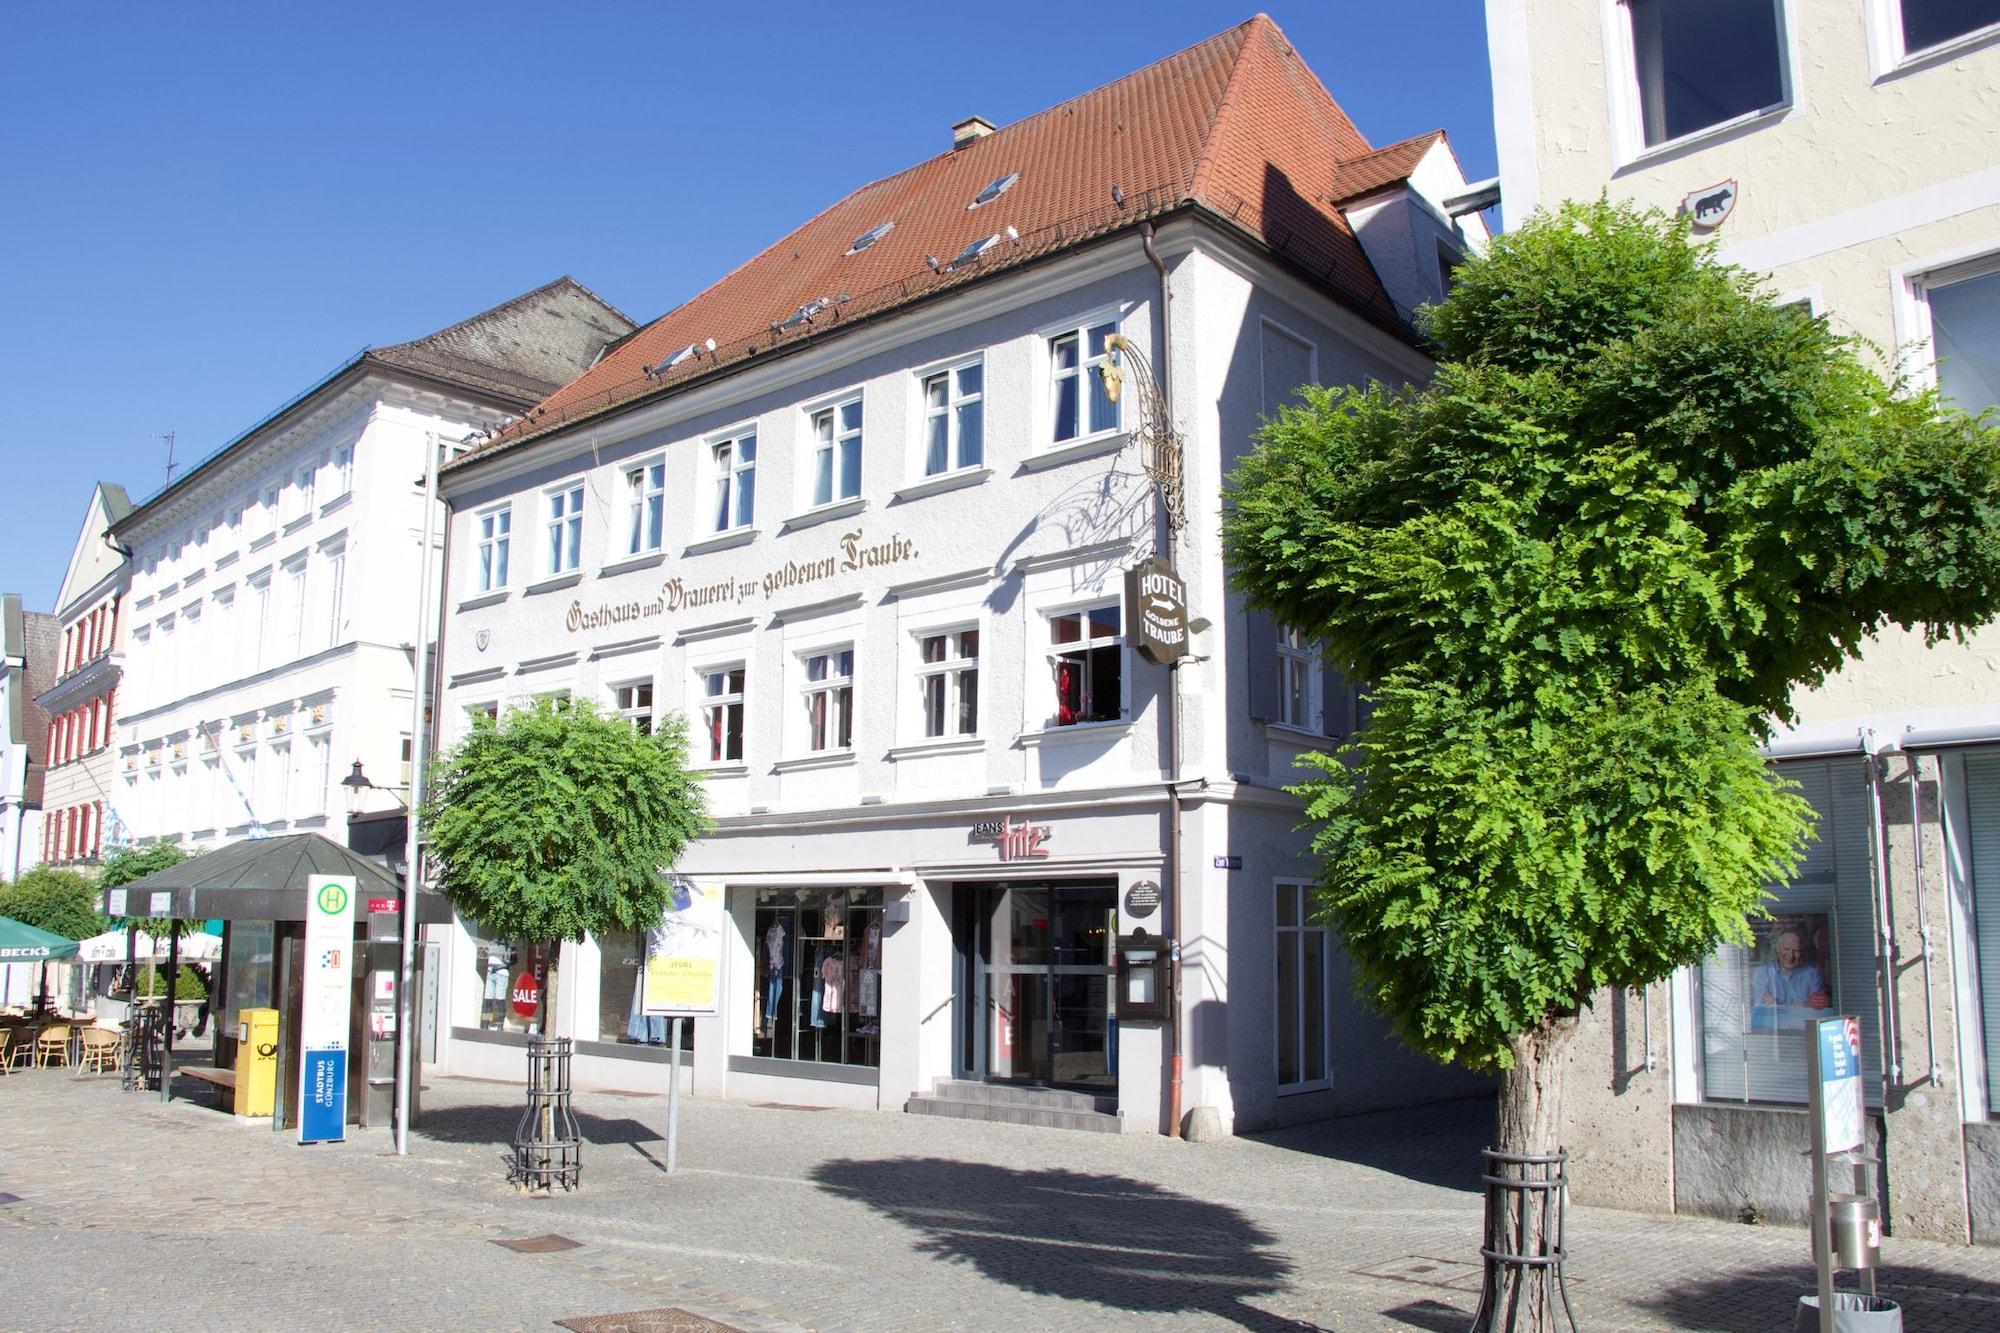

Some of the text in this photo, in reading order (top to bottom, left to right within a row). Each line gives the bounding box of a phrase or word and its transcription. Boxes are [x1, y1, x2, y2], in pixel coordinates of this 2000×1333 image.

[566, 600, 641, 632] Gasthaus
[643, 596, 664, 618] und
[662, 576, 735, 612] Brauerei
[737, 582, 758, 604] zur
[763, 556, 835, 599] goldenen
[1142, 573, 1184, 607] HOTEL
[1143, 618, 1185, 645] TRAUBE
[1145, 609, 1179, 627] GOLDENE
[973, 822, 1004, 836] JEANS
[326, 890, 340, 909] H
[512, 988, 537, 1004] SALE
[316, 1060, 326, 1104] STADTBUS
[324, 1060, 335, 1108] GÜNZBURG
